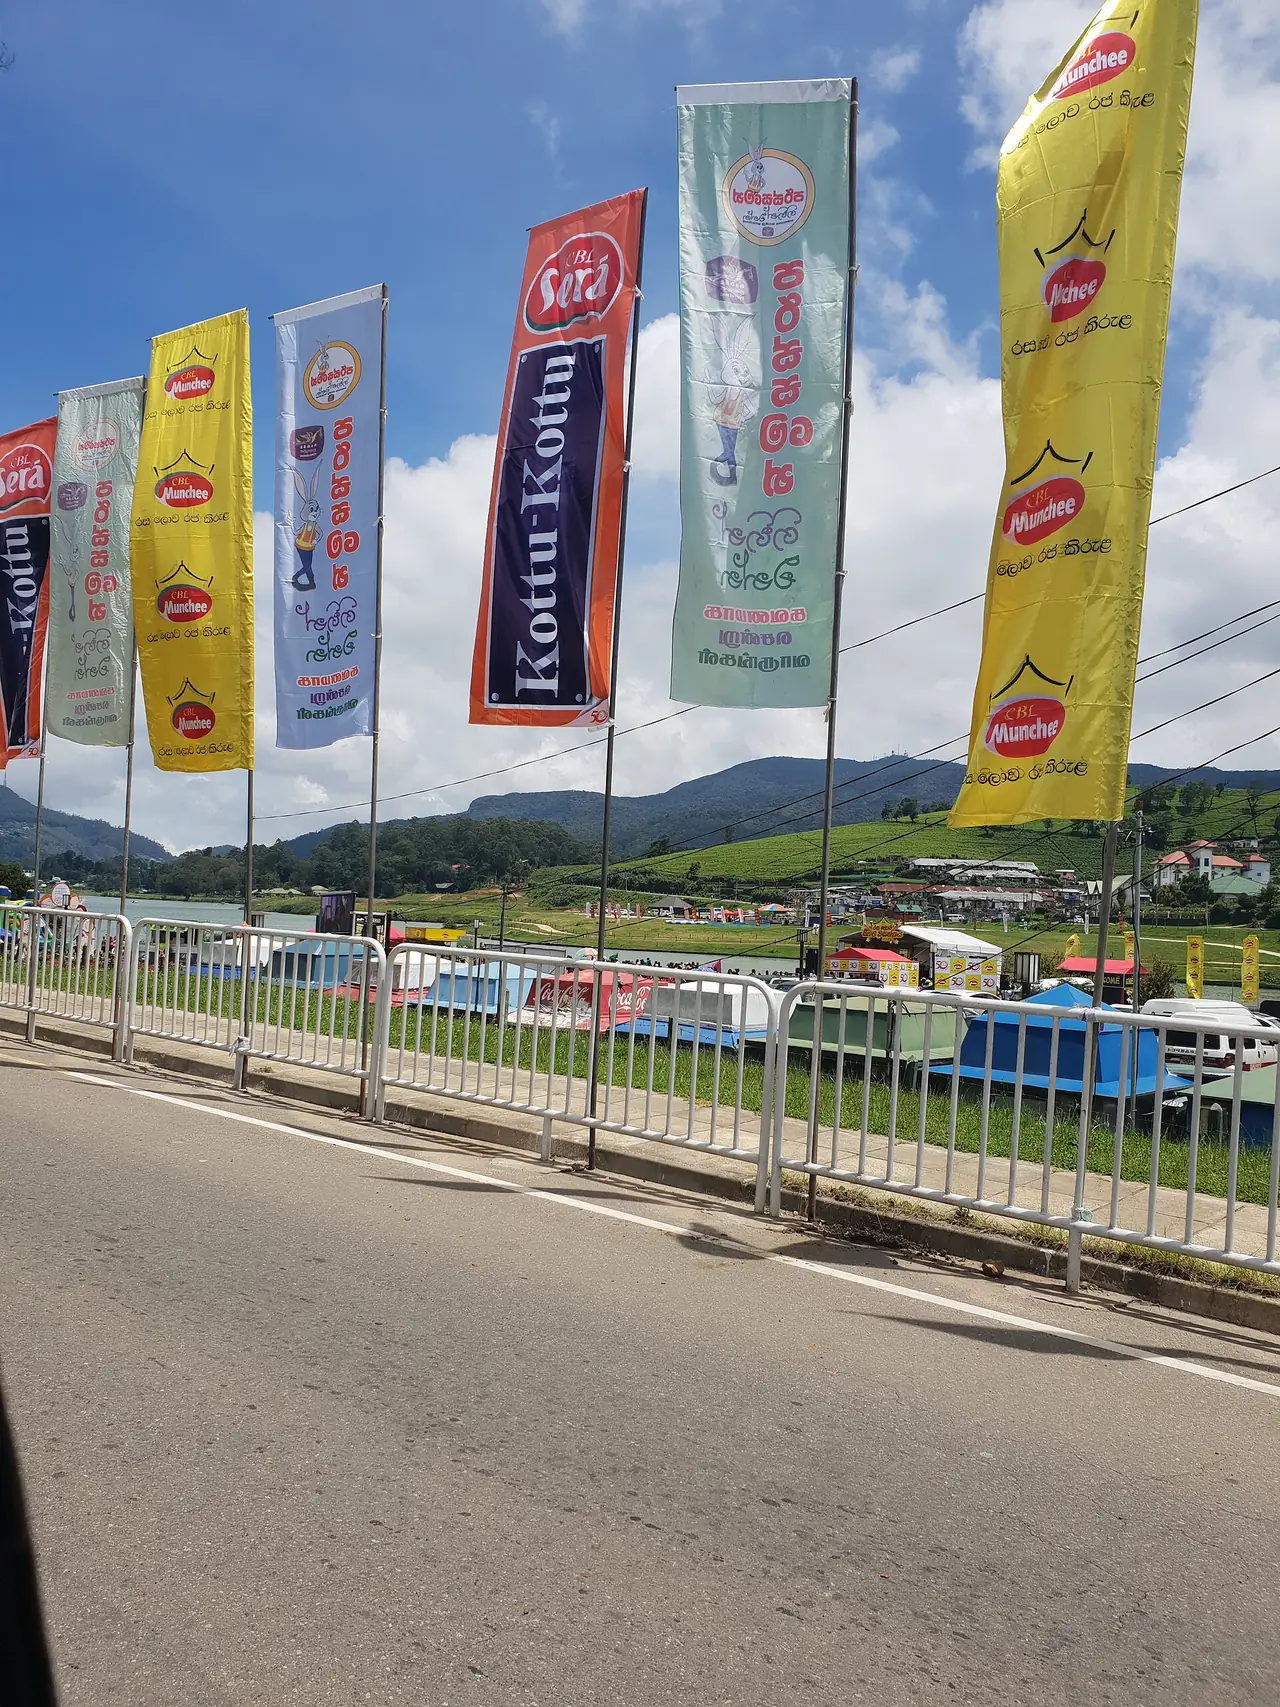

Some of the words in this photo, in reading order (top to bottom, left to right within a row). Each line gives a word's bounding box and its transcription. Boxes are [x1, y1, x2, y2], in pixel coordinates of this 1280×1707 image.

[538, 254, 609, 315] Será
[172, 377, 212, 393] Munchee
[164, 485, 209, 500] Munchee
[1026, 487, 1050, 508] CBL
[515, 352, 577, 698] Kottu-Kottu
[1009, 497, 1076, 535] Munchee
[164, 599, 208, 615] Munchee
[1004, 704, 1038, 721] CBL
[178, 715, 212, 731] Munchee
[990, 717, 1059, 744] Munchee
